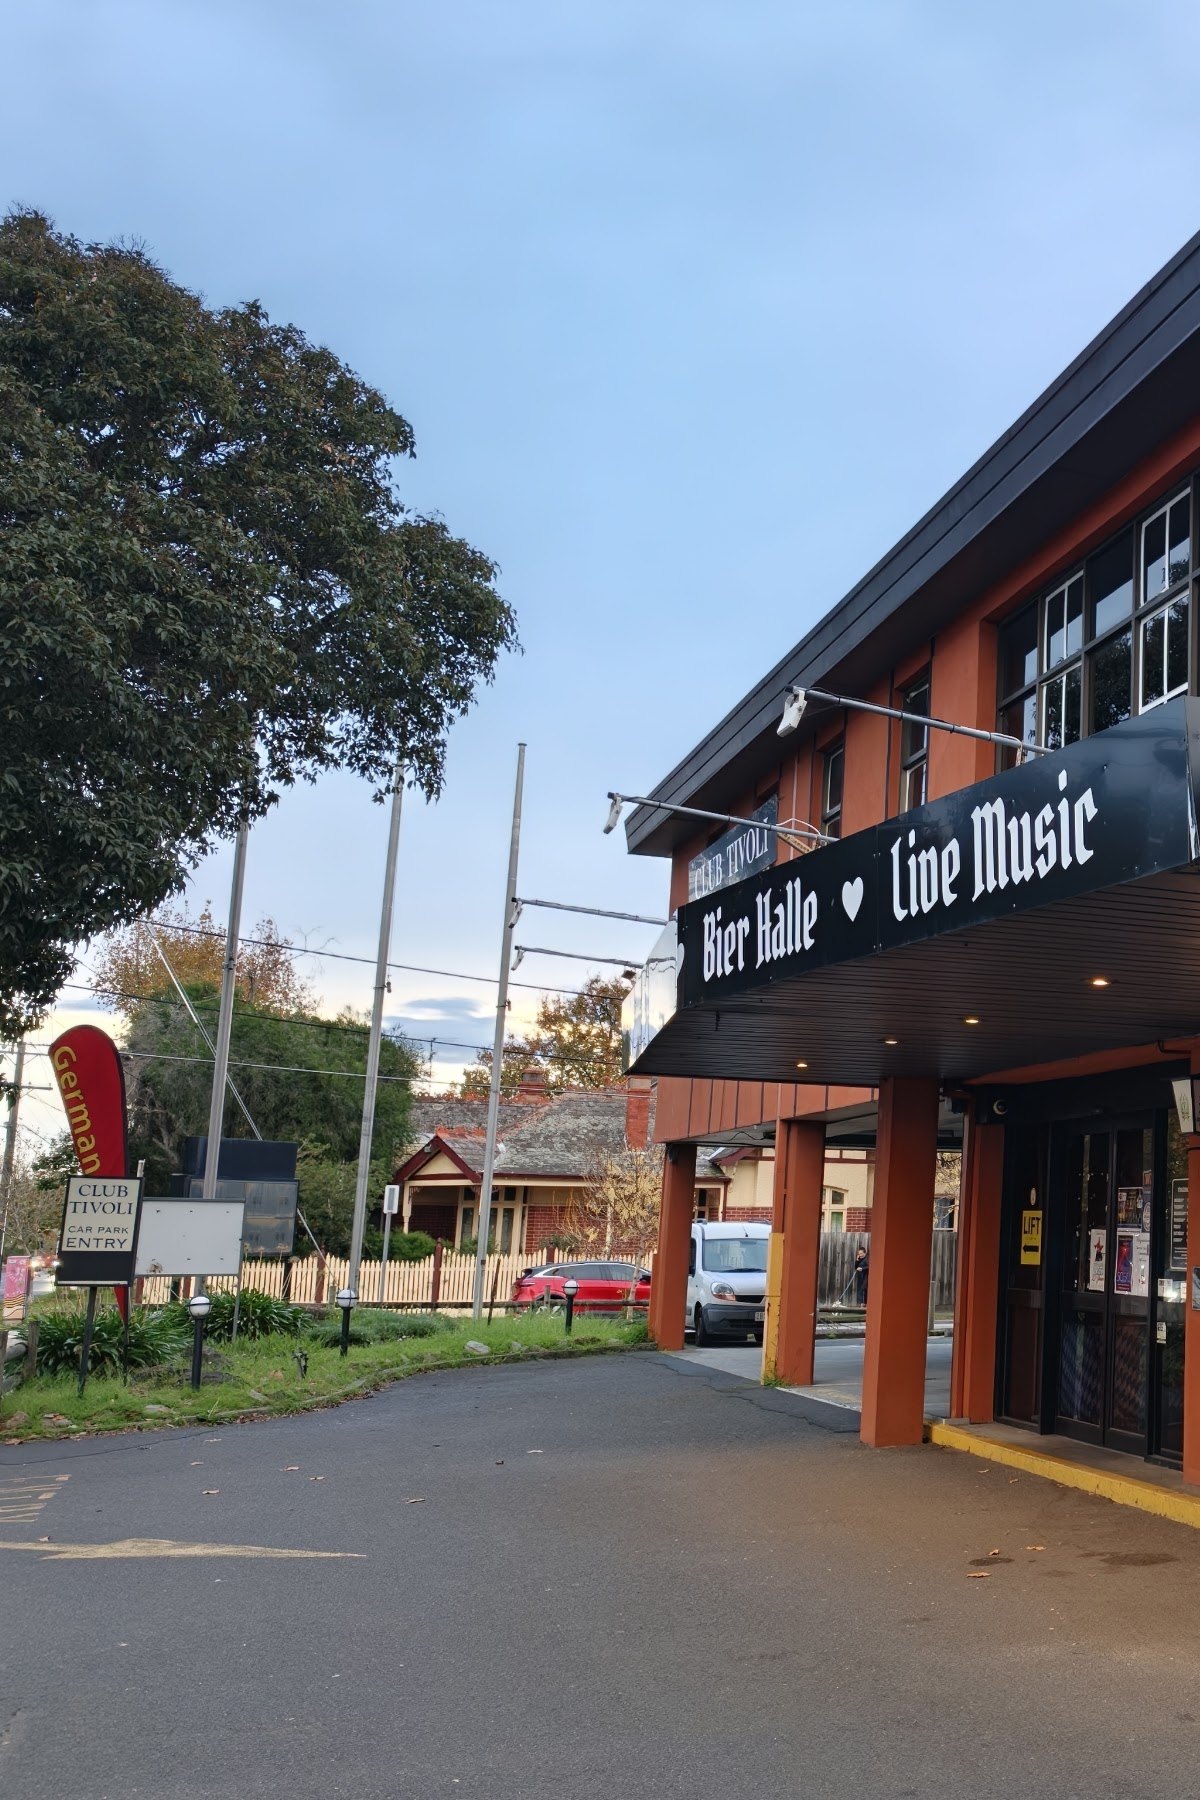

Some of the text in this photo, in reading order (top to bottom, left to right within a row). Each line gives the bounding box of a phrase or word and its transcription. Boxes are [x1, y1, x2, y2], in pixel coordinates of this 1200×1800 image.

[891, 769, 1099, 922] Live Music
[694, 817, 769, 900] CLUB TIVOLI
[703, 877, 818, 983] Bier Halle
[53, 1045, 101, 1175] German
[78, 1184, 129, 1198] CLUB
[69, 1201, 133, 1215] TIVOLI
[67, 1225, 129, 1234] CAR PARK
[1023, 1216, 1041, 1235] LIFT
[66, 1237, 128, 1249] ENTRY
